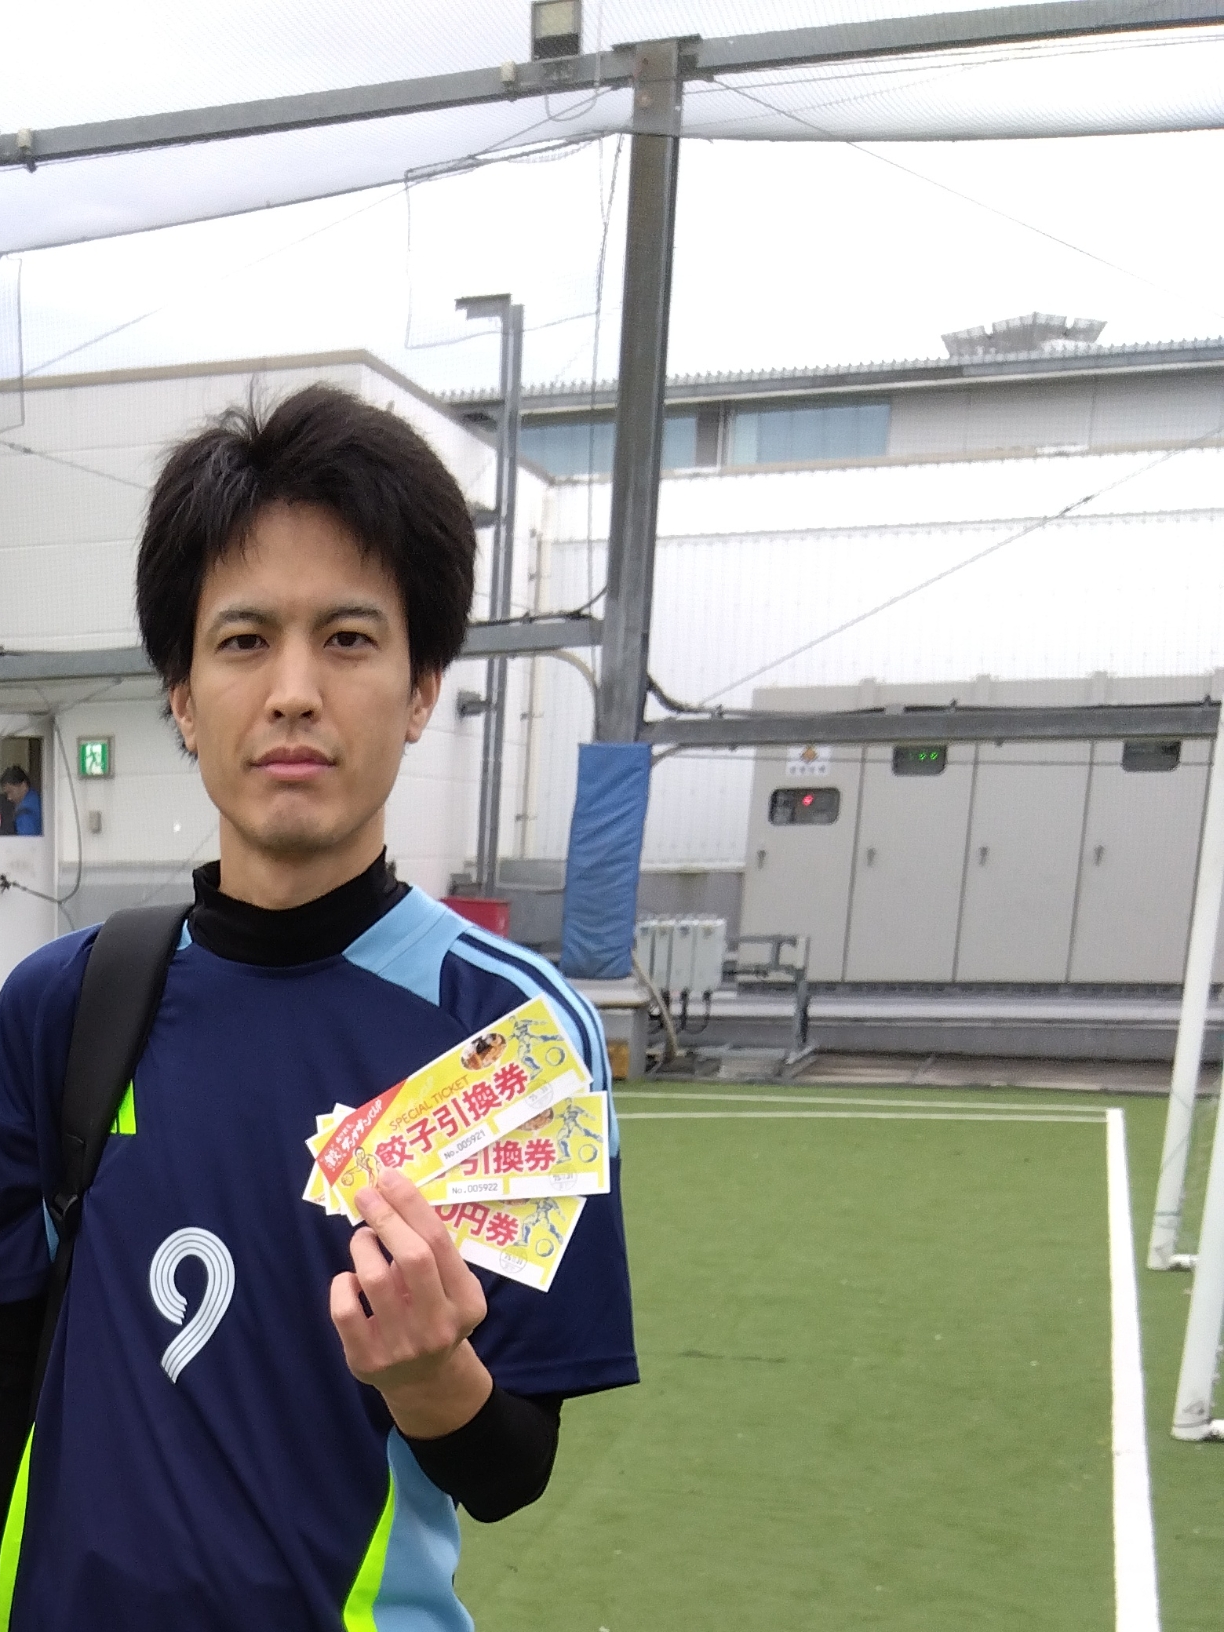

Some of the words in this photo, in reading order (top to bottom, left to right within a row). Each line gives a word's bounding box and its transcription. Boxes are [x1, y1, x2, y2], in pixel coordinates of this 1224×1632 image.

[375, 1062, 528, 1169] 餃子引換券
[389, 1099, 433, 1131] SPECIAL
[431, 1074, 470, 1109] TICKET
[451, 1182, 498, 1195] No.005922
[149, 1226, 236, 1384] 9
